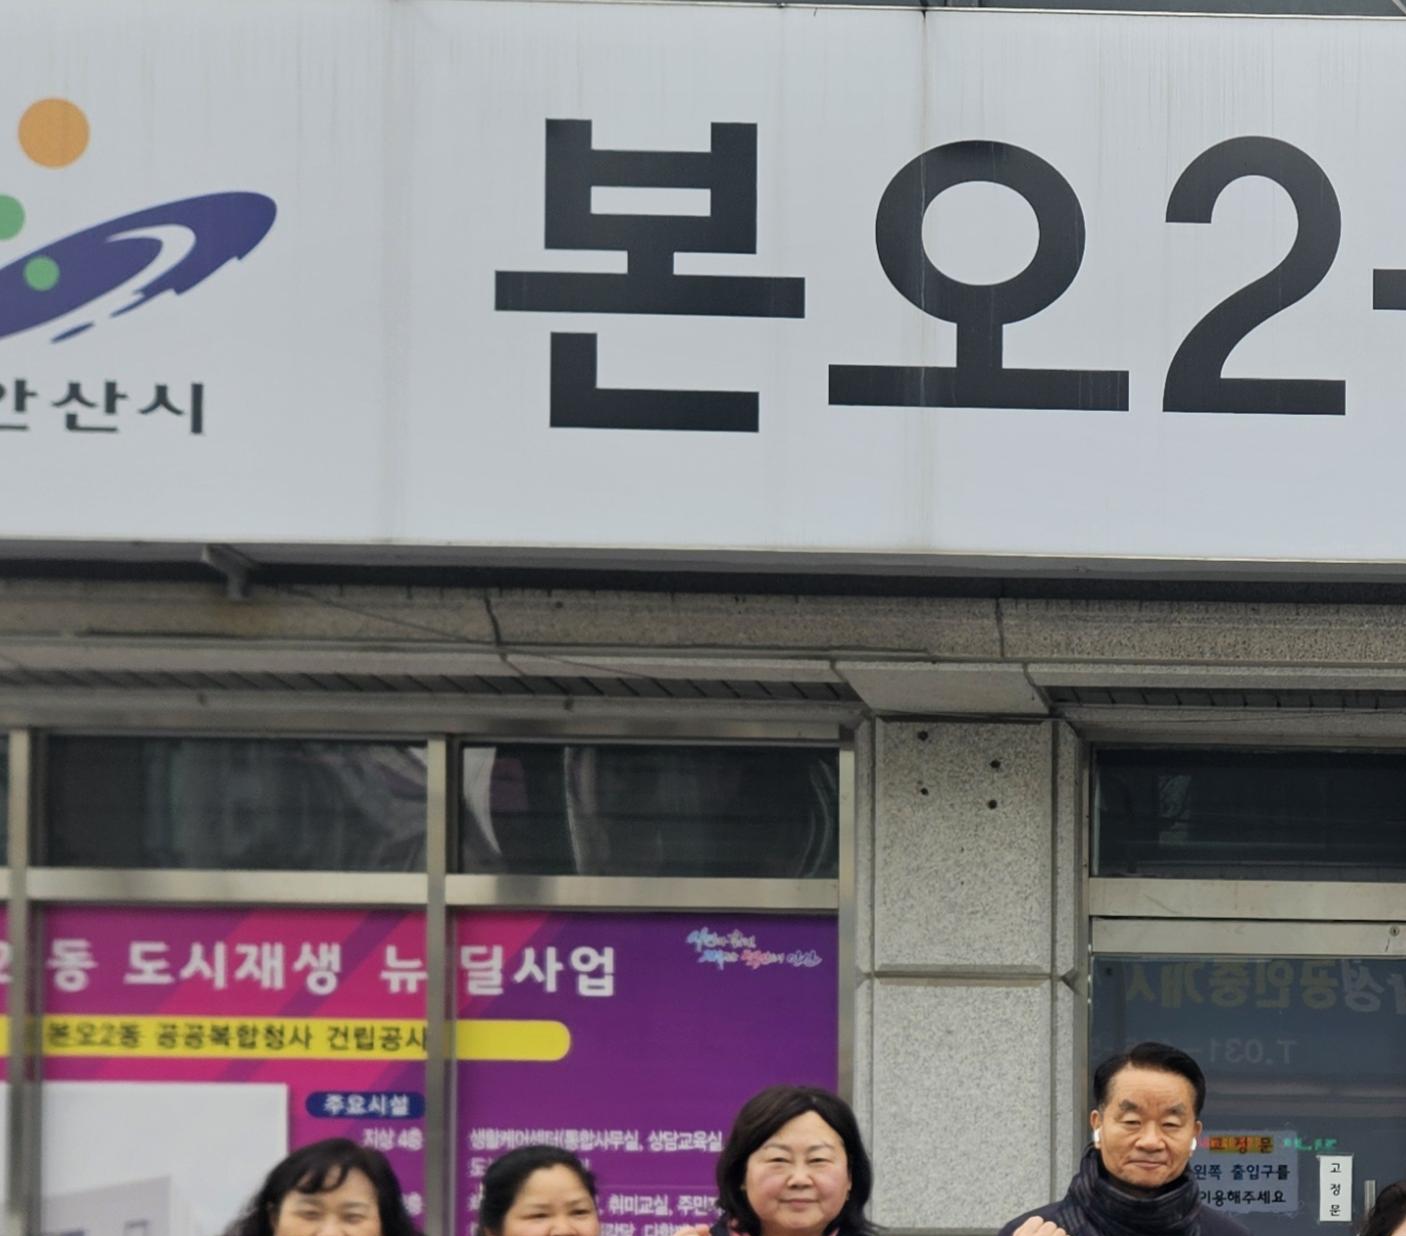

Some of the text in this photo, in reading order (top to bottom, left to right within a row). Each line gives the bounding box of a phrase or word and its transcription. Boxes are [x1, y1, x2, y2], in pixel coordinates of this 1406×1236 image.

[124, 941, 342, 995] 도시재생
[47, 1022, 428, 1052] 본오2동 공공복합청사 건립공사
[324, 1094, 410, 1116] 주요시설
[364, 1128, 393, 1150] 지상
